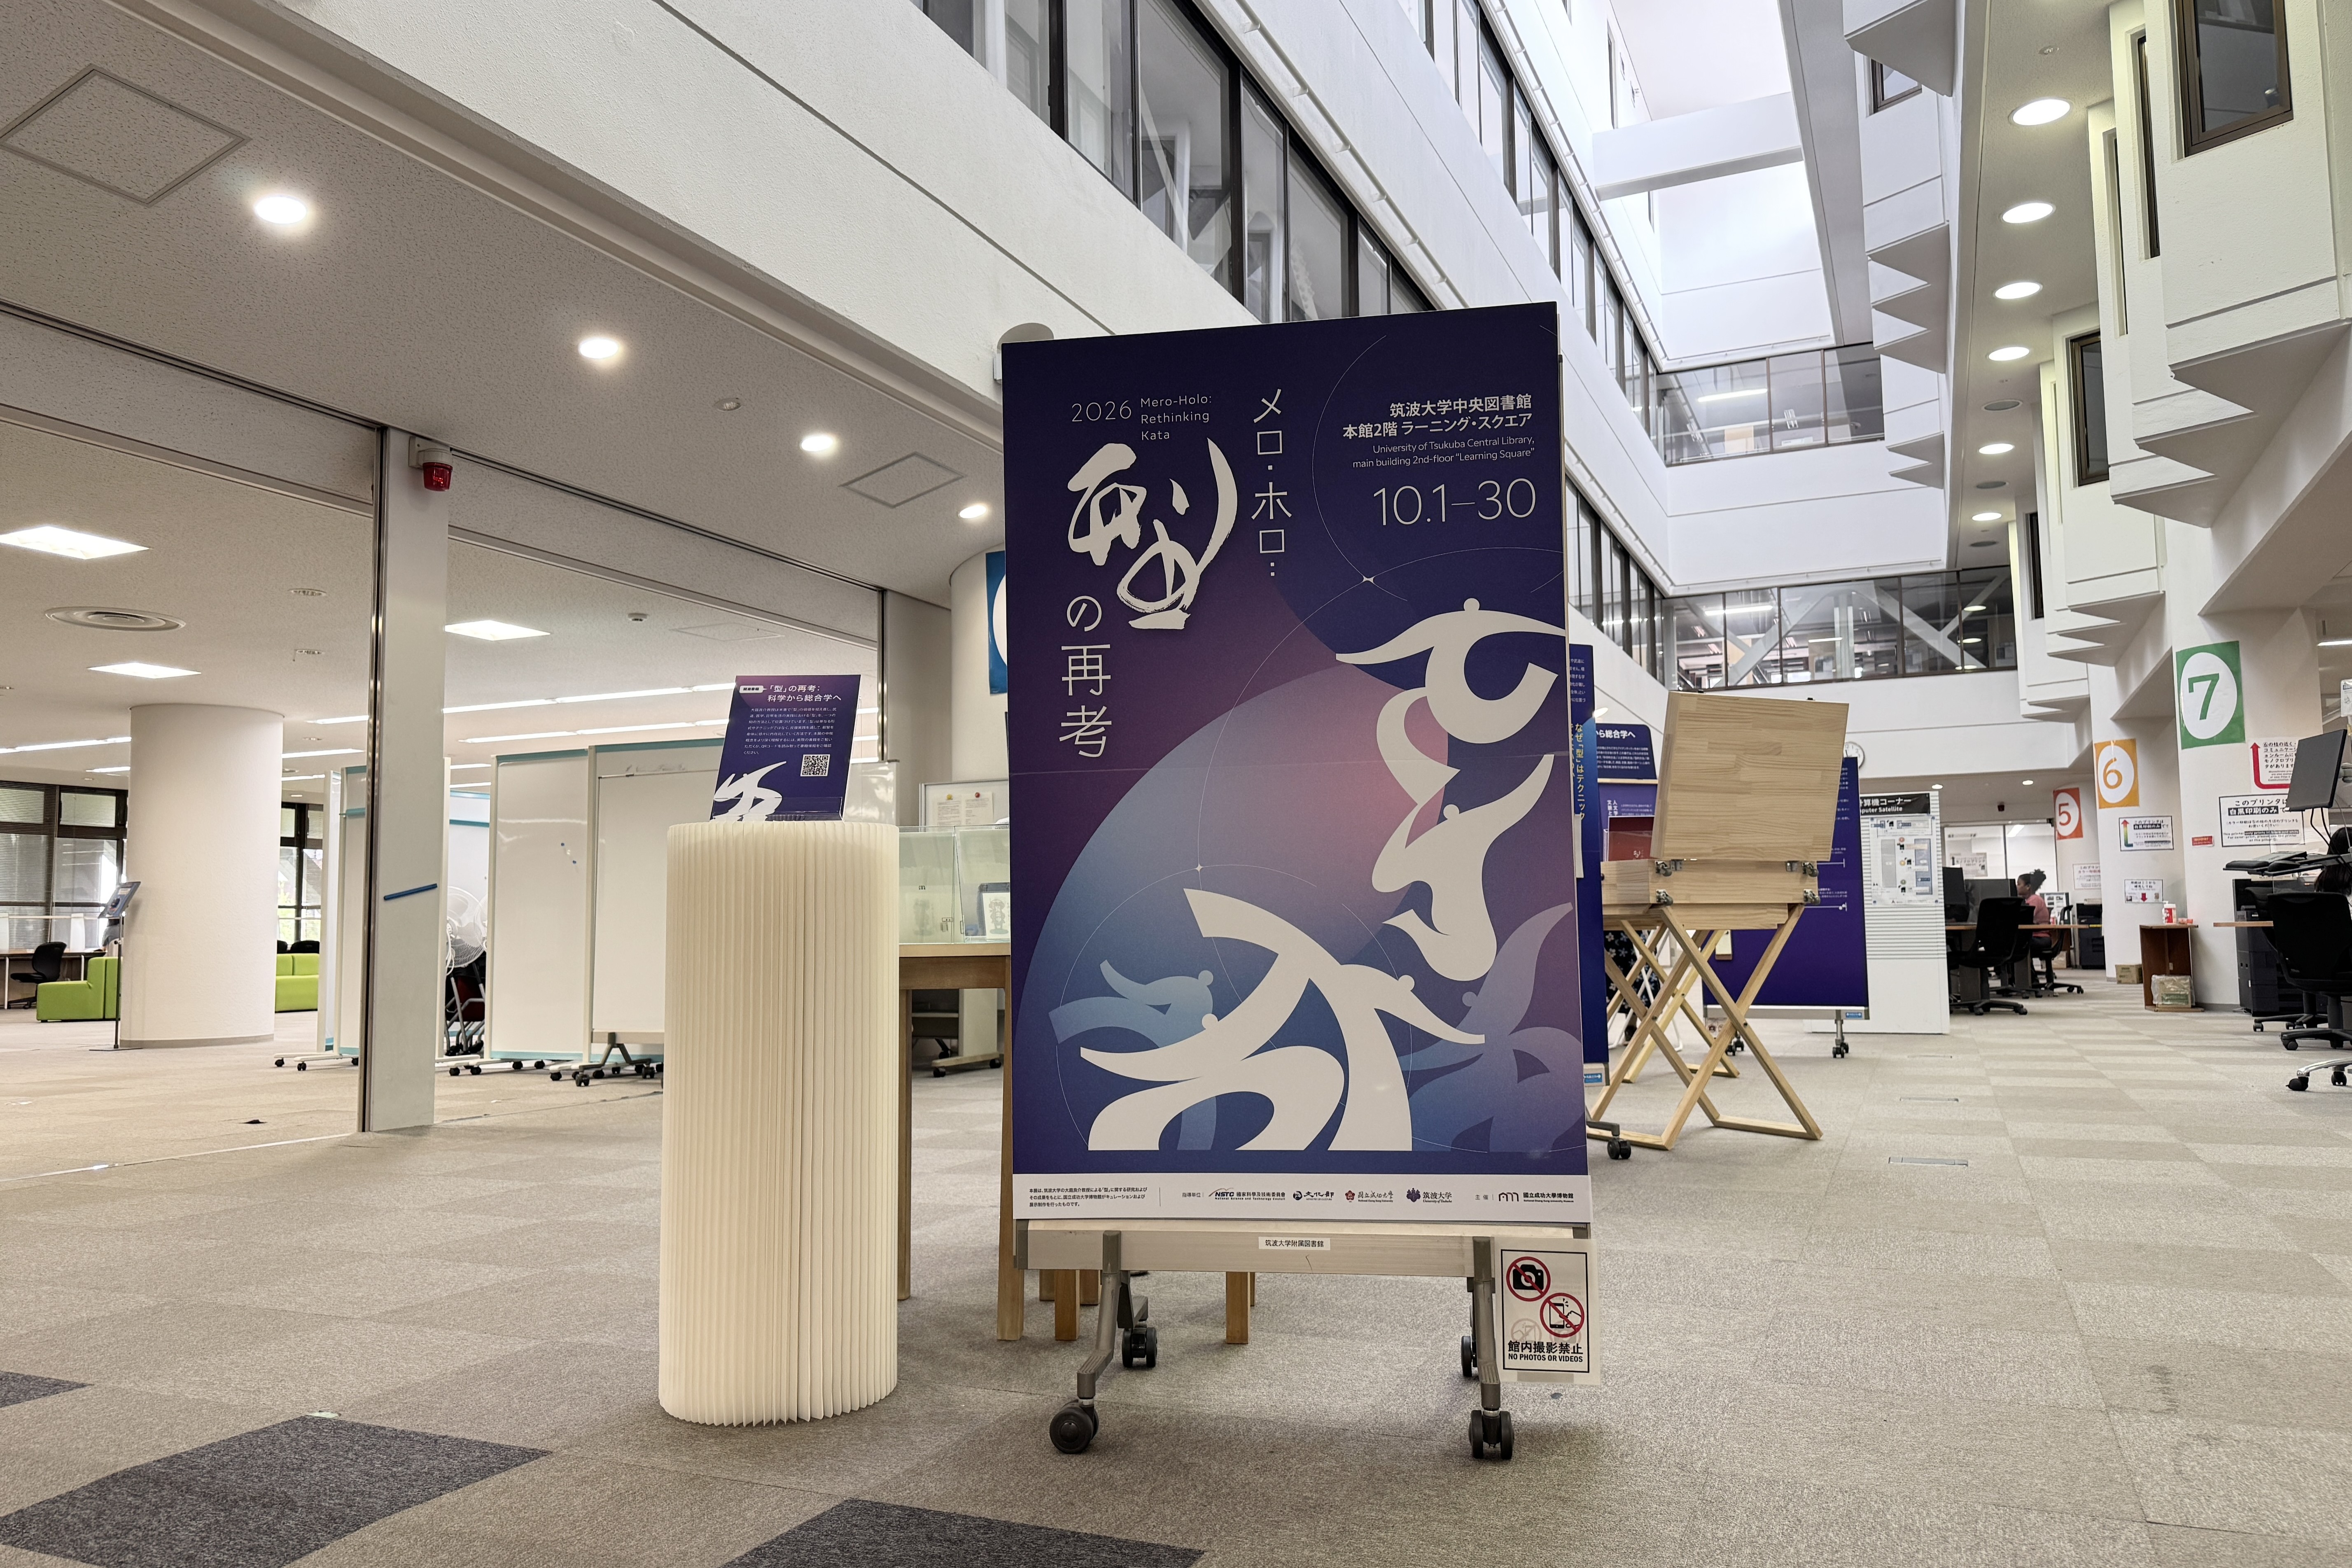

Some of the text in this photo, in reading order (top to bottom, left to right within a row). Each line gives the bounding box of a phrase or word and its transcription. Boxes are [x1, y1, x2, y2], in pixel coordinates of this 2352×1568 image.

[1140, 394, 1212, 408] Mero-Holo:
[1389, 393, 1532, 418] 筑波大学中央図書館
[1071, 400, 1132, 422] 2026
[1141, 411, 1210, 424] Rethinking
[1342, 413, 1533, 439] 本館2階 ラーニング・スクエア
[1141, 431, 1170, 441] Kata
[1373, 436, 1535, 453] University of Tsukuba Central Library,
[1376, 456, 1411, 467] building
[1412, 454, 1454, 464] 2nd-floor
[1059, 595, 1113, 758] の再考
[2188, 673, 2220, 720] 7
[1596, 729, 1636, 739] ら総合学へ
[2103, 757, 2123, 789] 6
[2058, 803, 2071, 826] 5
[1507, 1340, 1583, 1355] 館内撮影禁止
